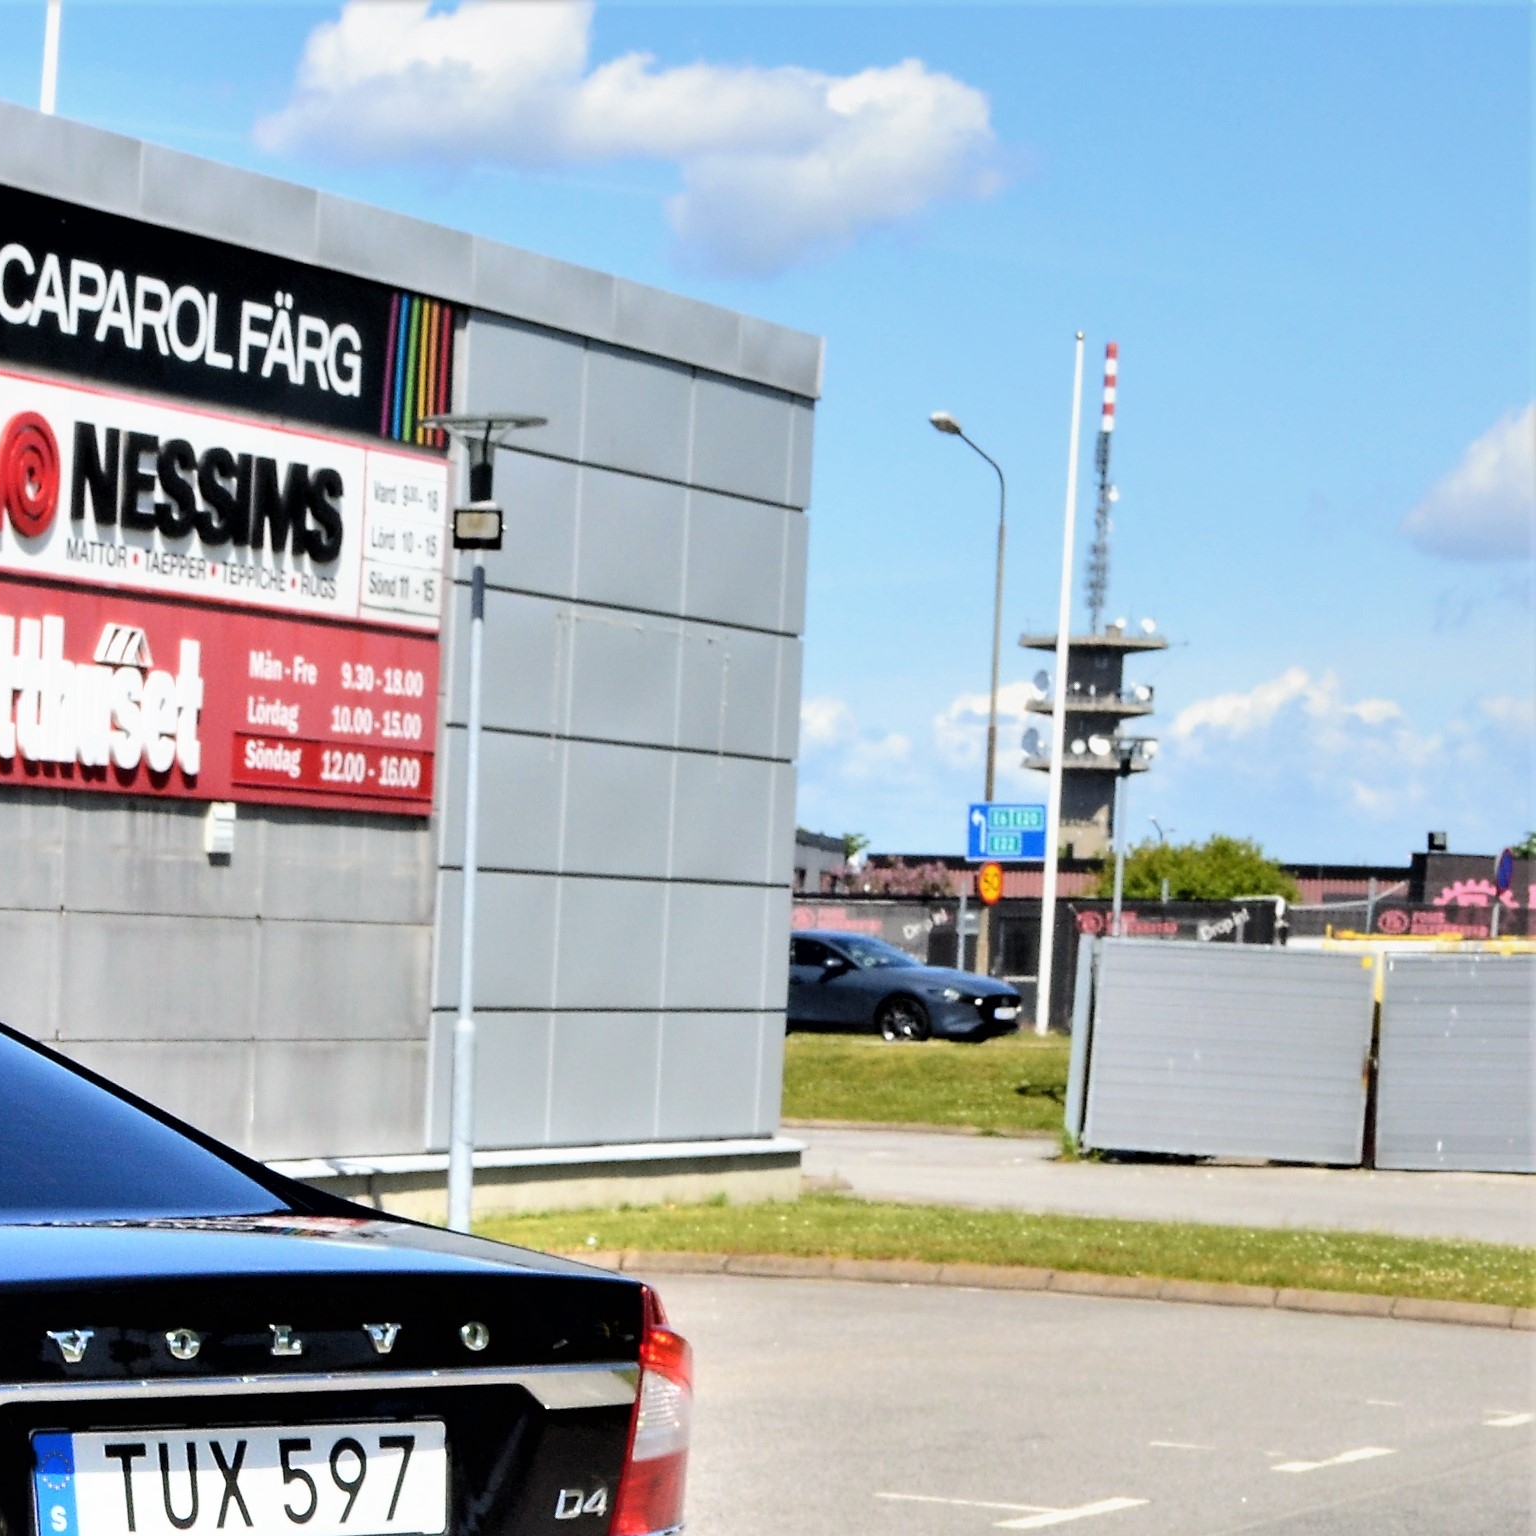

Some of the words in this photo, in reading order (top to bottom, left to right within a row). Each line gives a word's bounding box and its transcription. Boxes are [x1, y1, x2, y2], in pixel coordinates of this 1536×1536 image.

[239, 290, 362, 398] FÄRG
[70, 420, 344, 563] NESSIMS
[67, 538, 128, 568] MATTOR
[144, 549, 206, 581] TAEPPER
[222, 561, 287, 592] TEPPICHE
[301, 574, 337, 600] RUGS
[293, 656, 318, 685] Fre
[247, 696, 299, 734] Lördag
[245, 739, 302, 779] Söndag
[47, 1320, 490, 1363] VOLVO
[104, 1439, 255, 1533] TUX
[277, 1435, 416, 1524] 597
[554, 1487, 608, 1520] D4
[49, 1504, 68, 1532] S
